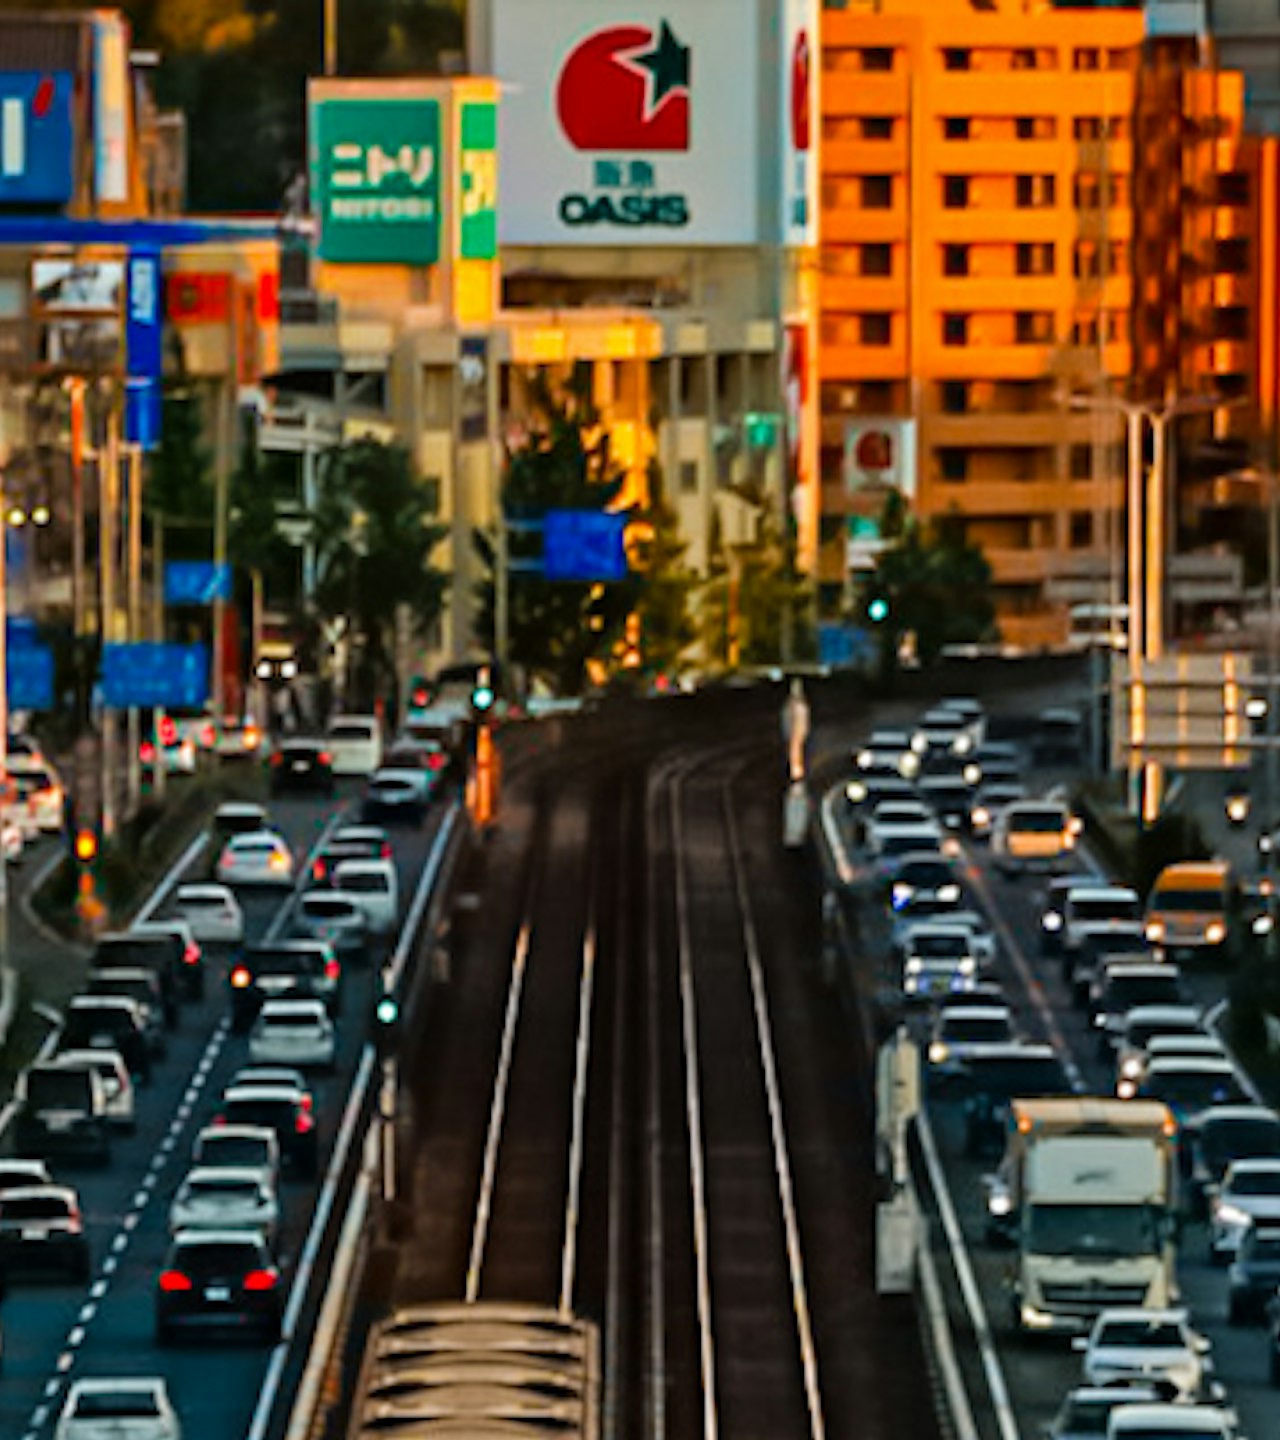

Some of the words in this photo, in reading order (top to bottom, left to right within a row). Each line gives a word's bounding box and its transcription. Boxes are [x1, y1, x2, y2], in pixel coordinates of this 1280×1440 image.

[331, 143, 434, 189] ニトリ
[331, 198, 434, 221] NITORI
[559, 194, 690, 227] OASIS
